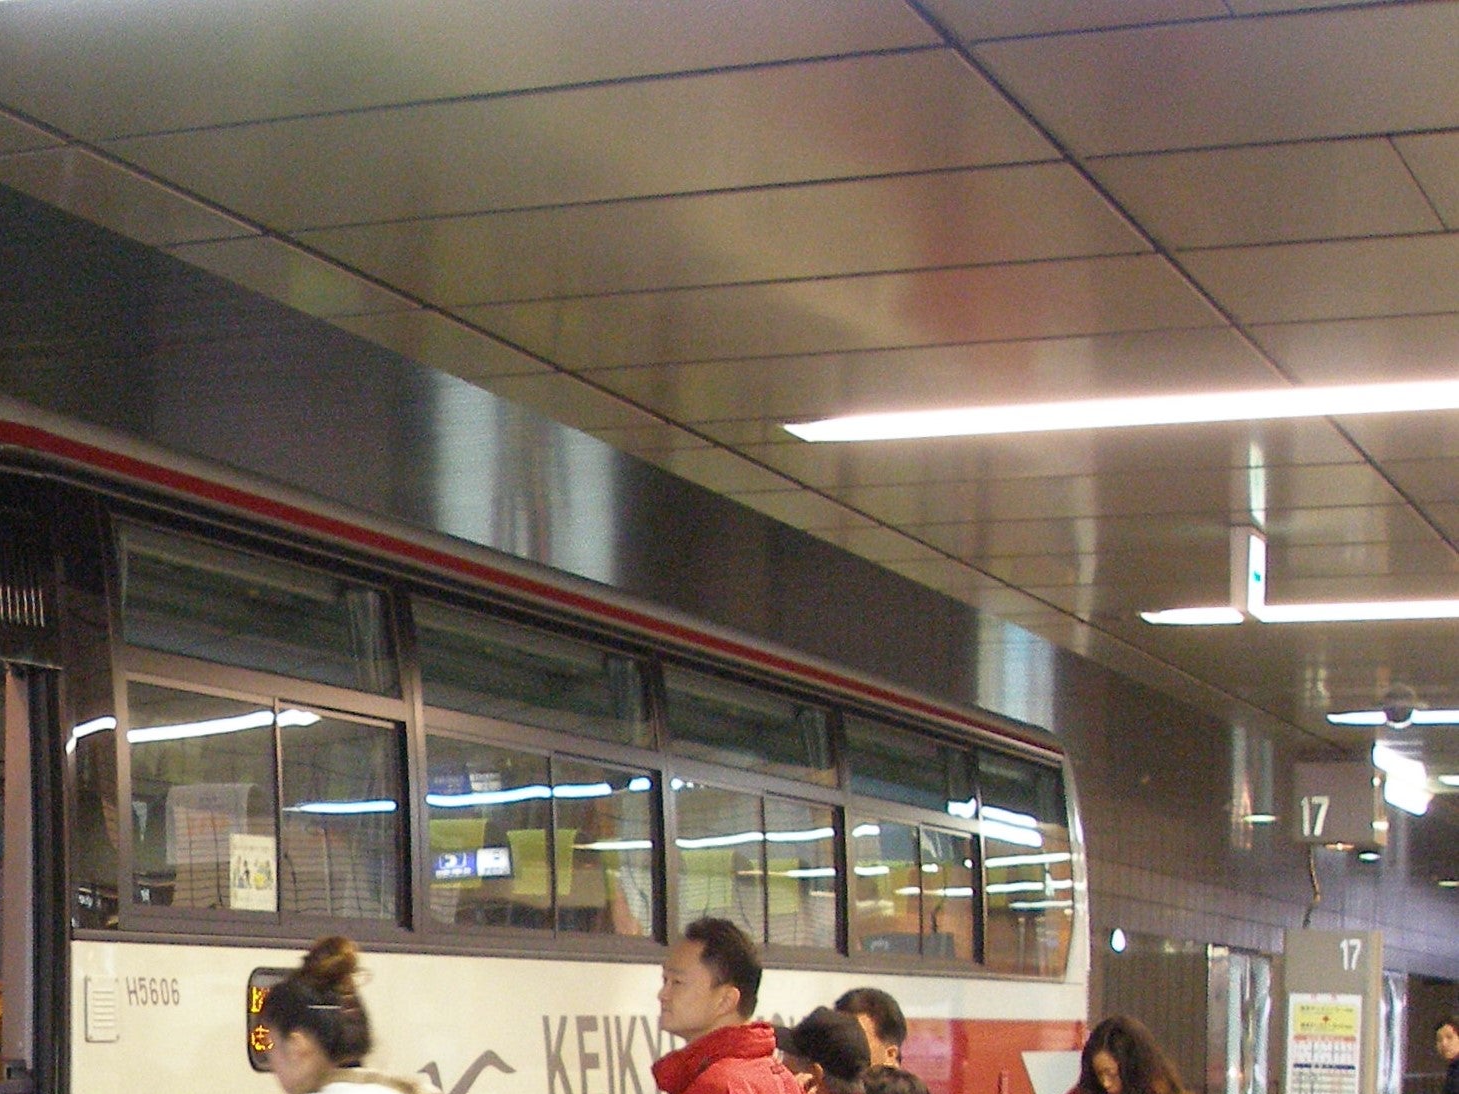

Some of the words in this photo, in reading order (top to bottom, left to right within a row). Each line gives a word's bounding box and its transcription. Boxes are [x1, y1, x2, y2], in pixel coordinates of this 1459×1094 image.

[1300, 795, 1330, 837] 17
[1340, 938, 1362, 971] 17
[125, 975, 180, 1007] H5606
